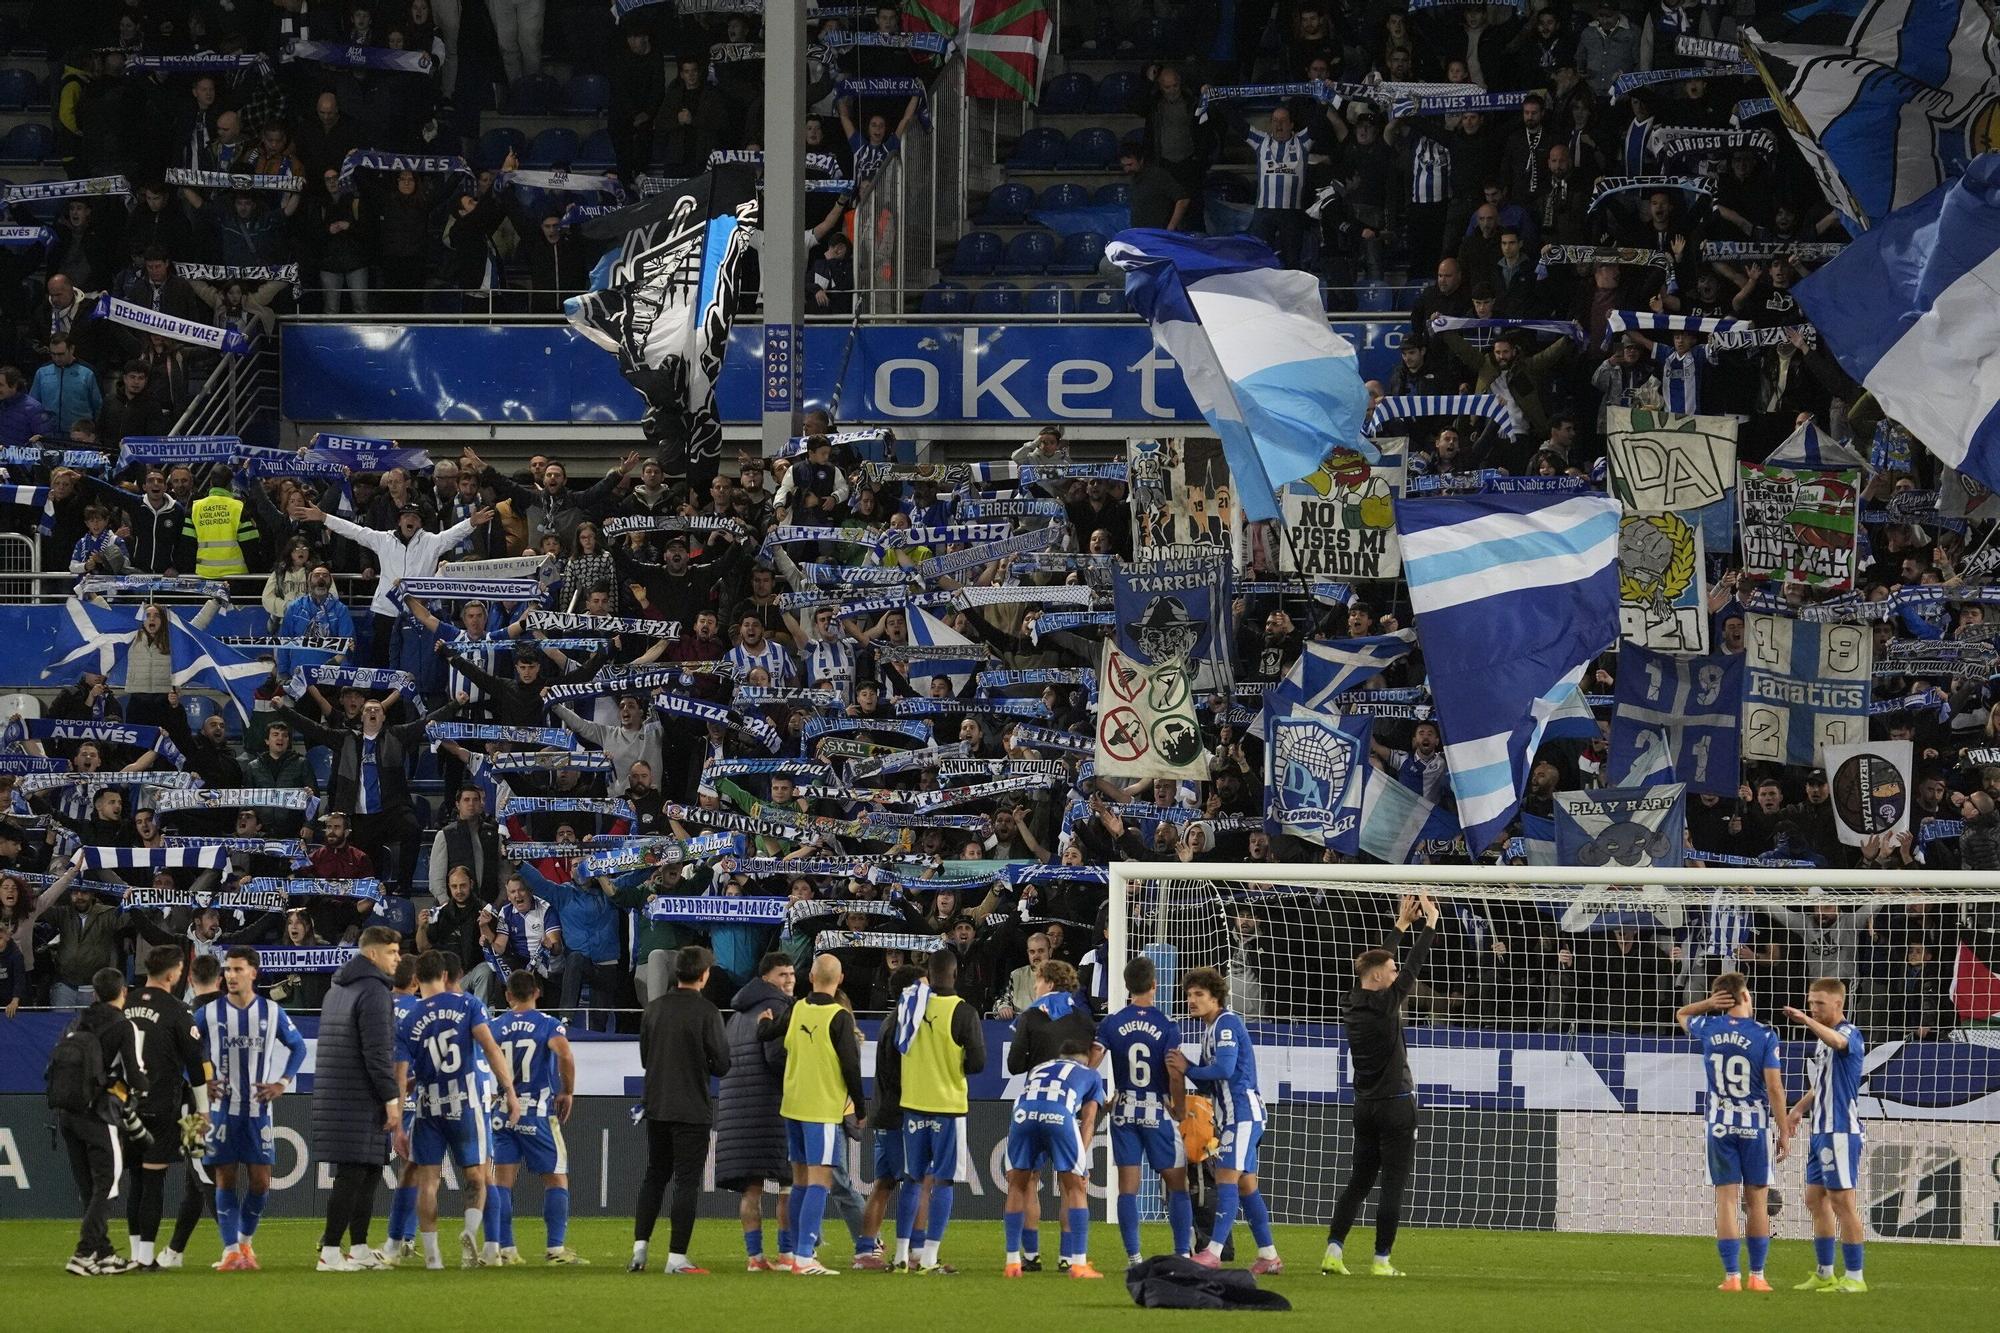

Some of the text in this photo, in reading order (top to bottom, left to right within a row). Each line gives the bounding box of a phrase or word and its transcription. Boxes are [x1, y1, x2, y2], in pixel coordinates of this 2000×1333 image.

[163, 54, 236, 62] INCANSABLES
[875, 327, 1176, 418] oket
[1622, 437, 1719, 506] DA
[1299, 501, 1335, 528] NO
[1291, 526, 1387, 554] PISES MI
[1119, 562, 1157, 576] ZUEN
[1164, 555, 1226, 572] AMETSIK
[1294, 549, 1380, 577] JARDIN
[416, 582, 478, 592] DEPORTIVO
[1748, 673, 1865, 709] Fanatics
[56, 718, 114, 729] DEPORTIVO
[50, 726, 139, 744] ALAVÉS
[1569, 796, 1675, 816] PLAY HARD
[686, 806, 787, 838] KOMANDO
[1277, 811, 1331, 823] GLORIOSO
[665, 898, 779, 917] DEPORTIVO ALAVÉS
[124, 1006, 161, 1024] SIVERA
[409, 1007, 467, 1042] LUCAS BOVÉ
[501, 1021, 536, 1036] J.OTTO
[1118, 1021, 1163, 1041] GUEVARA
[424, 1027, 462, 1075] 15
[1710, 1031, 1752, 1050] IBAÑEZ
[1128, 1042, 1151, 1088] 6
[1709, 1053, 1751, 1098] 19
